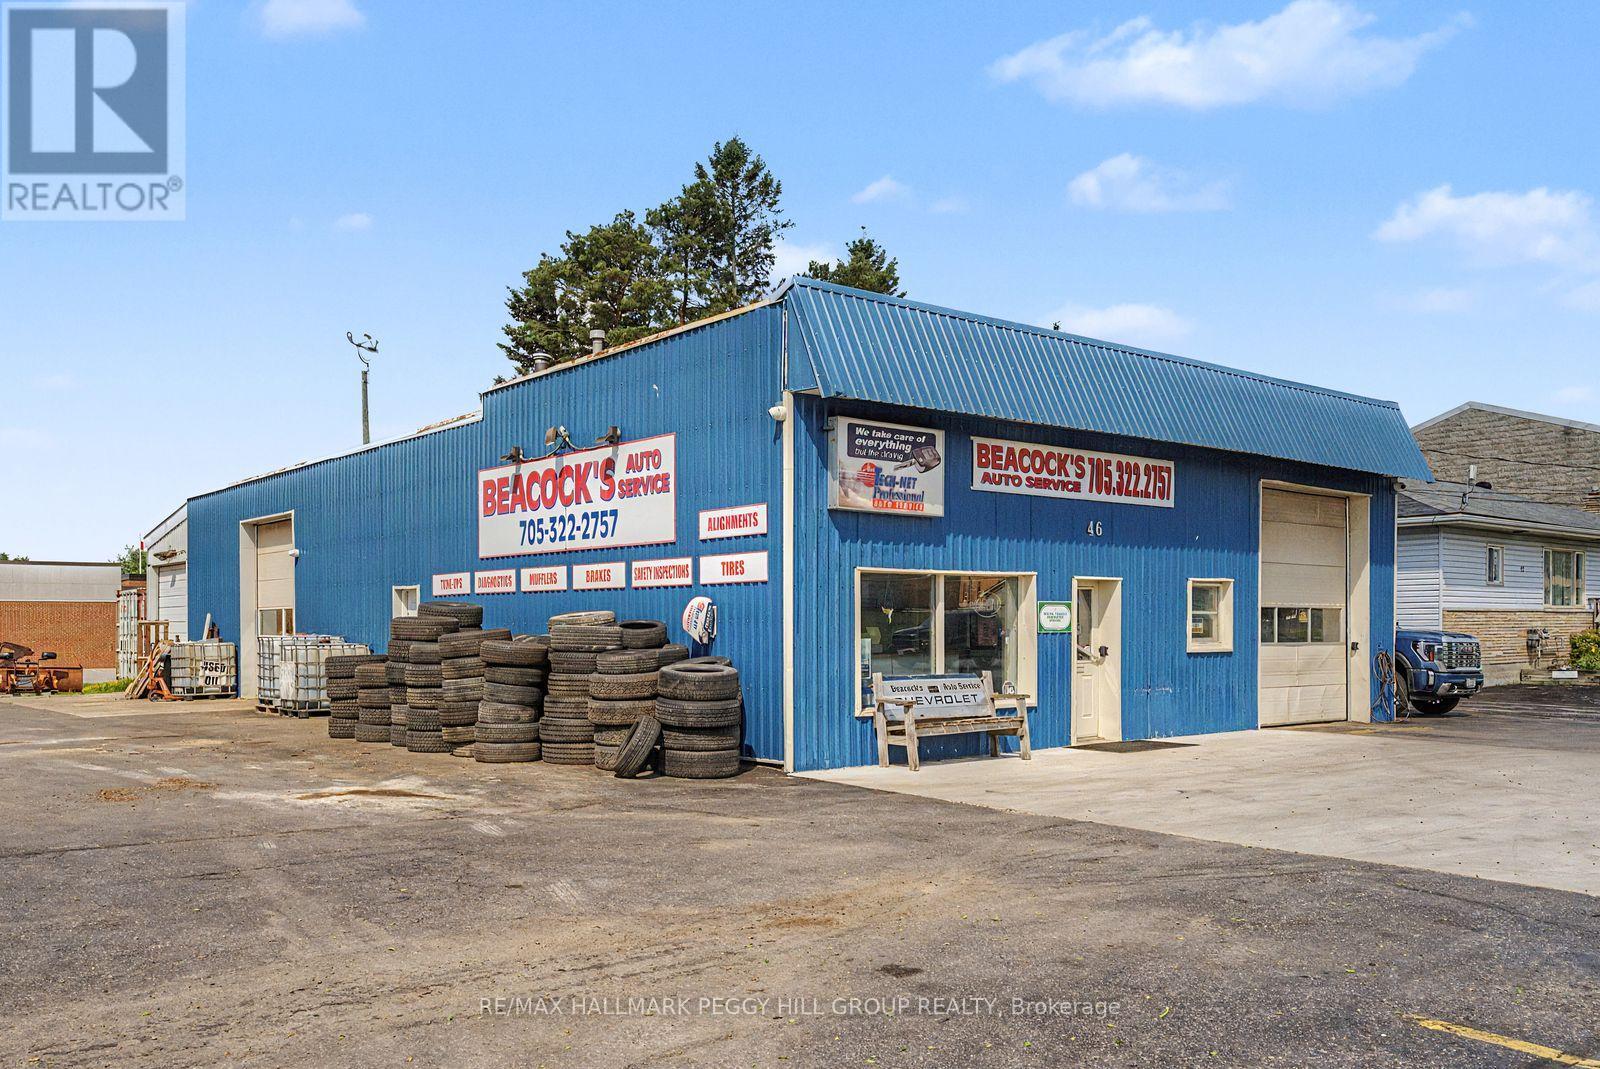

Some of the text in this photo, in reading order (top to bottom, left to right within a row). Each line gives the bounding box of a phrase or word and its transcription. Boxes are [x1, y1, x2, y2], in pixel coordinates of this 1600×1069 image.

[855, 427, 926, 443] We take care of
[855, 438, 912, 453] everything
[625, 448, 662, 474] AUTO
[976, 442, 1086, 480] BEACOCK'S
[482, 457, 616, 518] BEACOCK'S
[617, 472, 671, 500] SERVICE
[980, 471, 1082, 494] AUTO SERVICE
[1087, 457, 1172, 501] 705.322.2757
[873, 487, 925, 502] Professional
[519, 509, 619, 546] 705-322-2757
[707, 511, 759, 533] ALIGNMENTS
[1086, 520, 1104, 538] 46
[585, 568, 612, 584] BRAKES
[633, 563, 690, 582] SAFETY INSPECTIONS
[720, 559, 746, 577] TIRES
[440, 577, 463, 591] TUNE-UPS
[477, 574, 513, 590] DIAGNOSTICS
[529, 571, 558, 587] MUFFLERS
[895, 693, 979, 707] EVROLET
